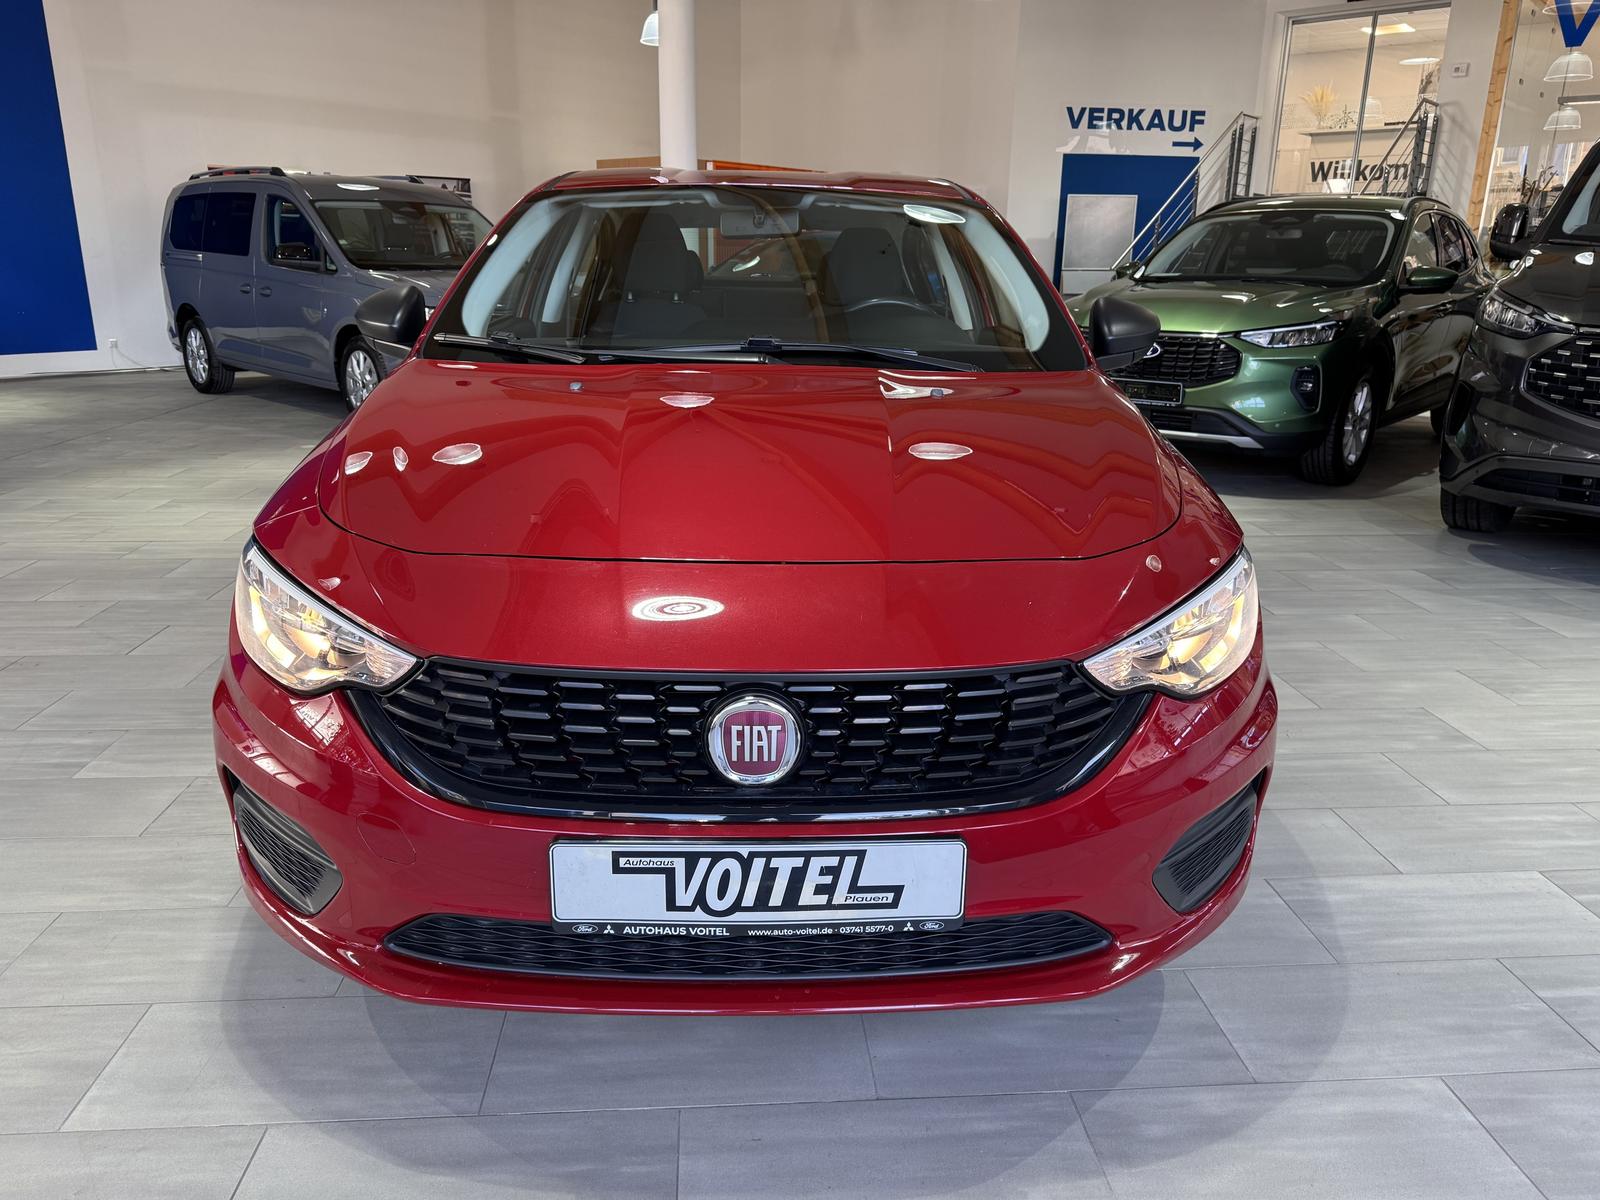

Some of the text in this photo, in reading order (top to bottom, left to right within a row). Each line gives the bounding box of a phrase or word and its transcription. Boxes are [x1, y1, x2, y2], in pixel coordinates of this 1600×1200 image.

[1066, 106, 1206, 132] VERKAUF
[1310, 159, 1425, 182] Willkom
[731, 725, 781, 762] FIAT
[623, 858, 675, 867] Autohaus
[674, 855, 894, 911] VOITEL
[844, 895, 889, 903] Plauen
[623, 925, 894, 936] AUTOHAUS VOITEL www.auto-voitel.de 03741 5577-0
